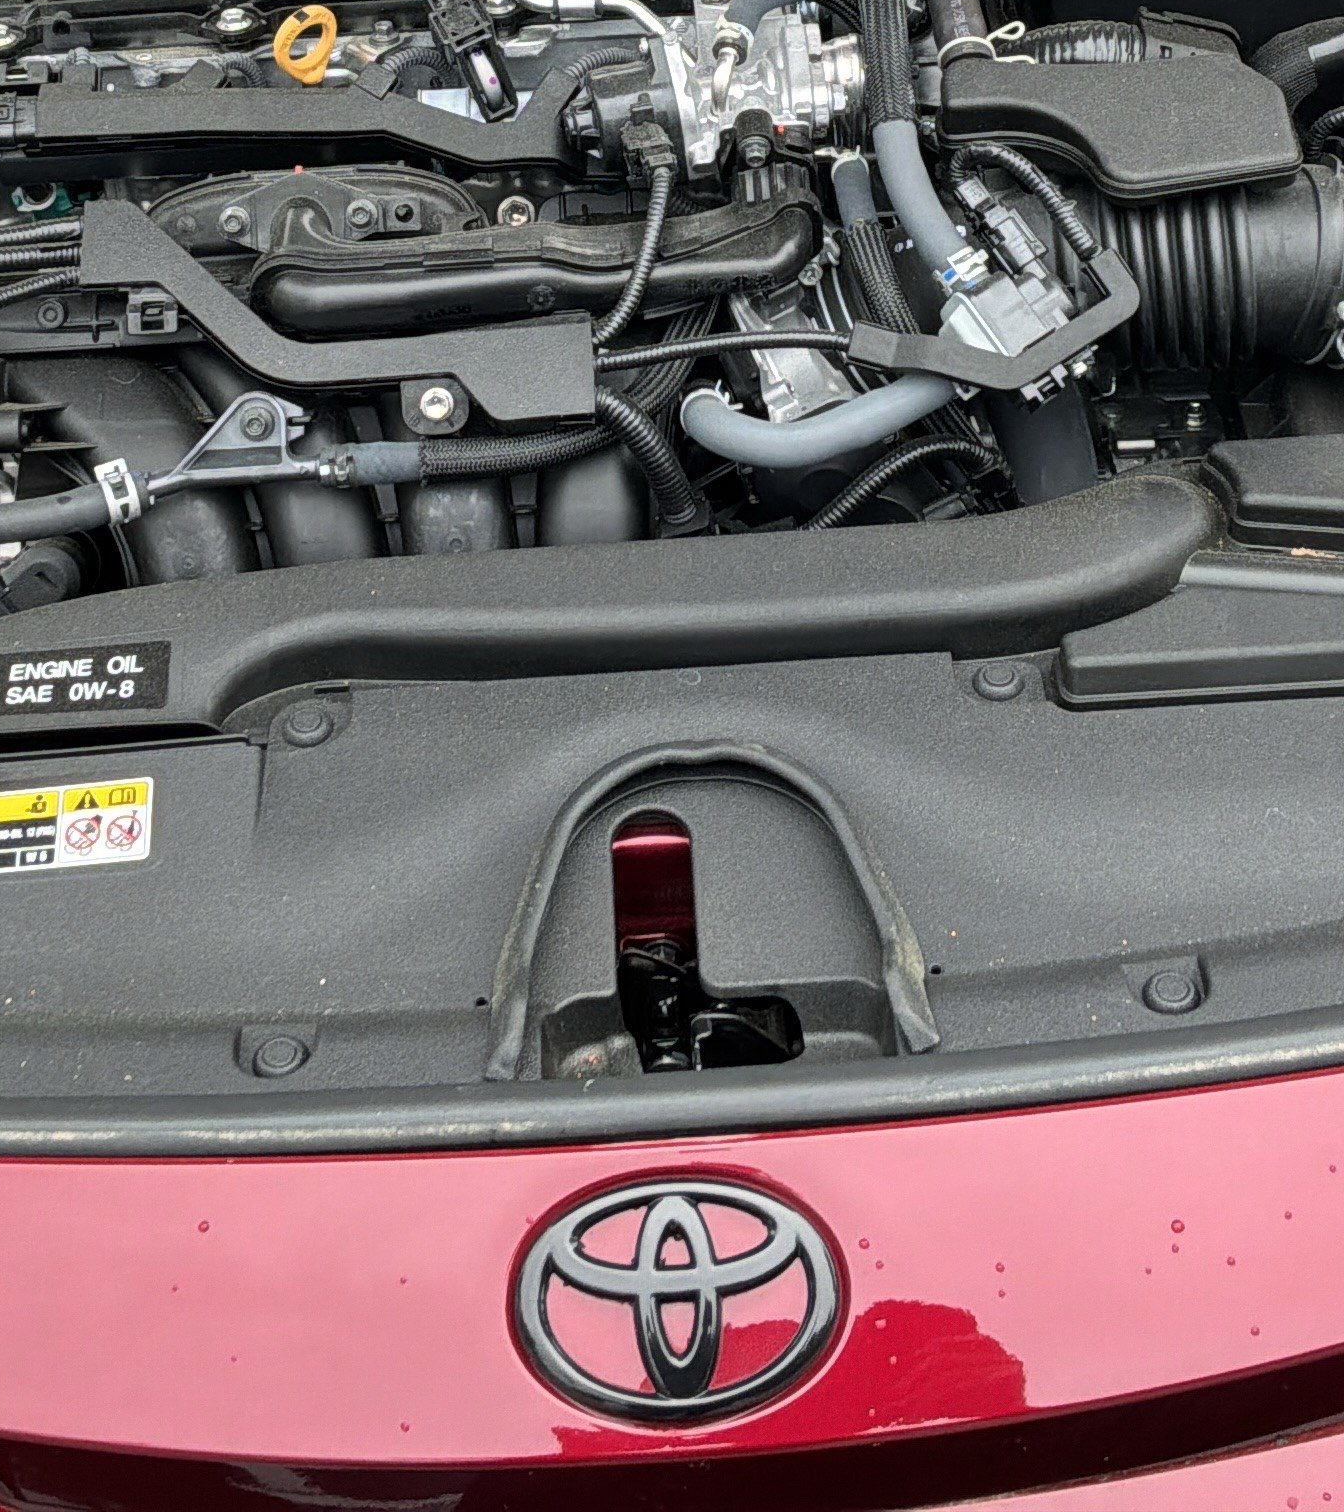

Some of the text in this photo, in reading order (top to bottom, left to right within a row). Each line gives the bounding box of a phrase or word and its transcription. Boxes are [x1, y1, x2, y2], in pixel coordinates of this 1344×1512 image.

[8, 654, 145, 682] ENGINE OIL
[5, 680, 135, 705] SAE 0W-8
